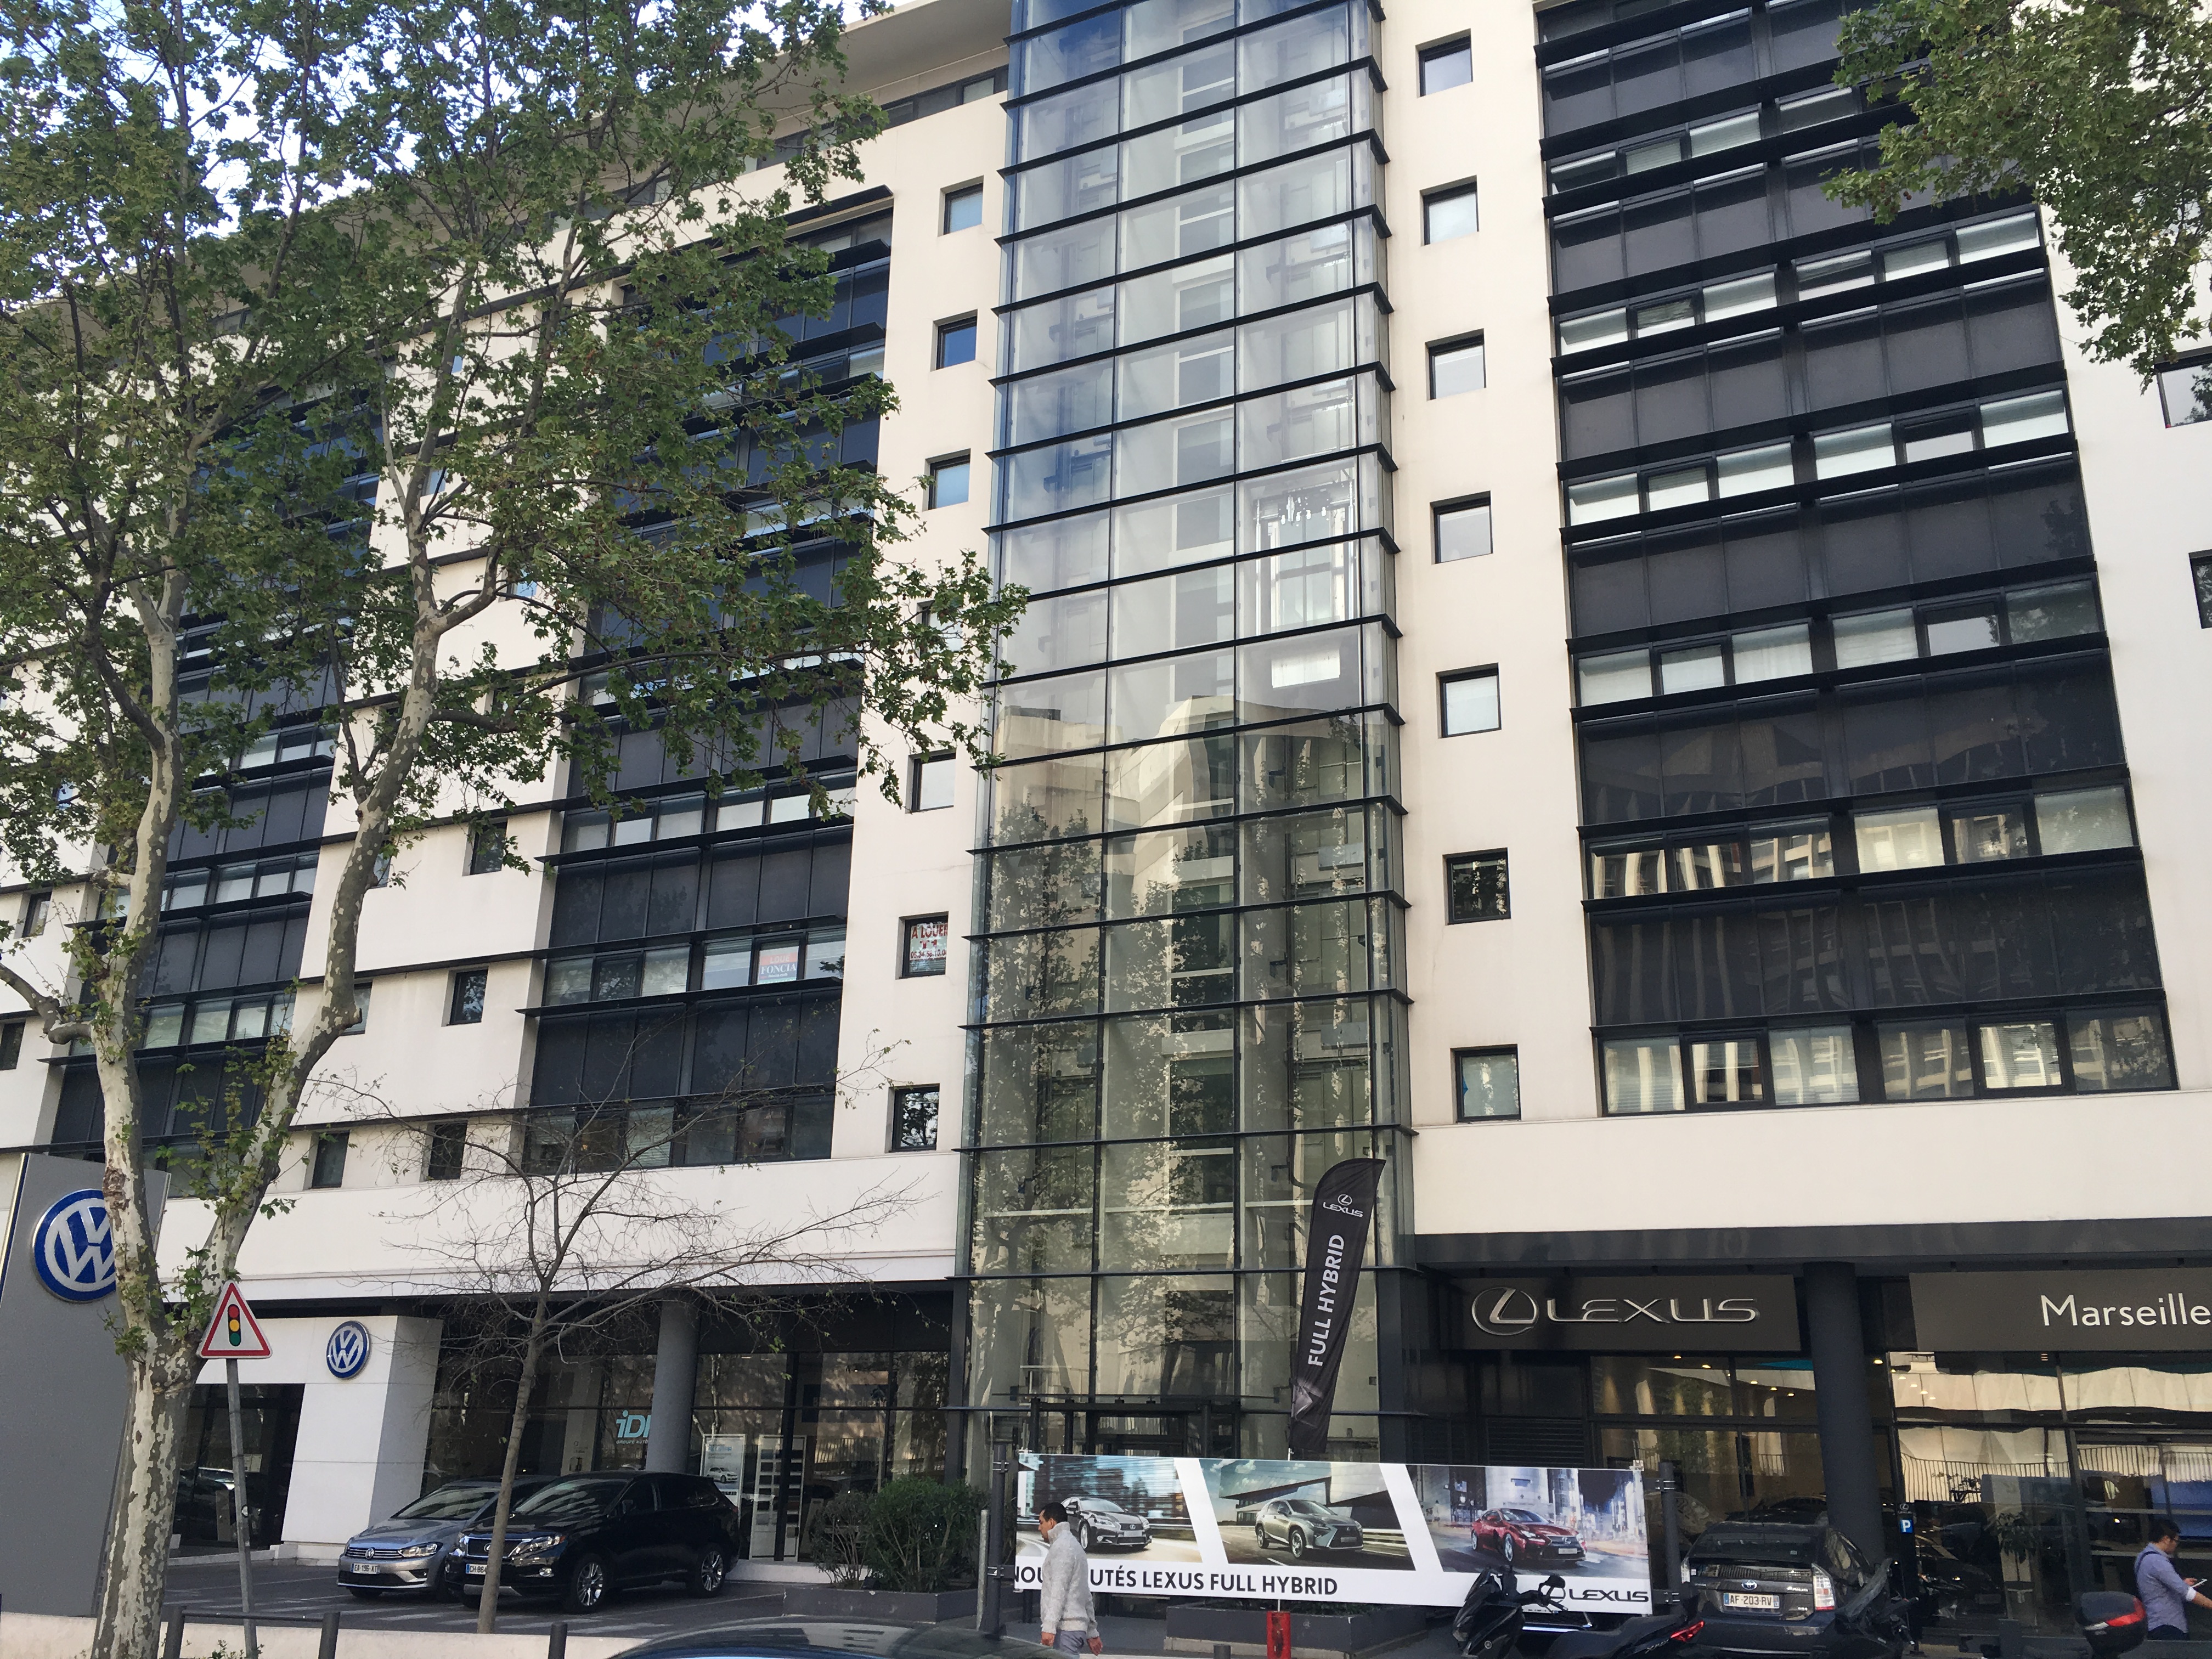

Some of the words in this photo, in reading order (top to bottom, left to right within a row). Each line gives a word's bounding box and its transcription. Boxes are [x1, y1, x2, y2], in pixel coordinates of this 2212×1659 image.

[911, 926, 918, 939] A
[761, 963, 797, 974] FONCIA
[1323, 1201, 1363, 1217] LEXUS
[1317, 1234, 1345, 1313] HYBRID
[1547, 1298, 1760, 1323] LEXUS
[2041, 1293, 2211, 1326] Marseille
[1307, 1318, 1331, 1367] FULL
[1901, 1520, 1911, 1532] P
[1142, 1571, 1204, 1590] LEXUS
[1210, 1573, 1256, 1593] FULL
[1262, 1575, 1338, 1595] HYBRID
[1568, 1588, 1649, 1602] LEXUS
[1730, 1594, 1772, 1607] AF-203-RV
